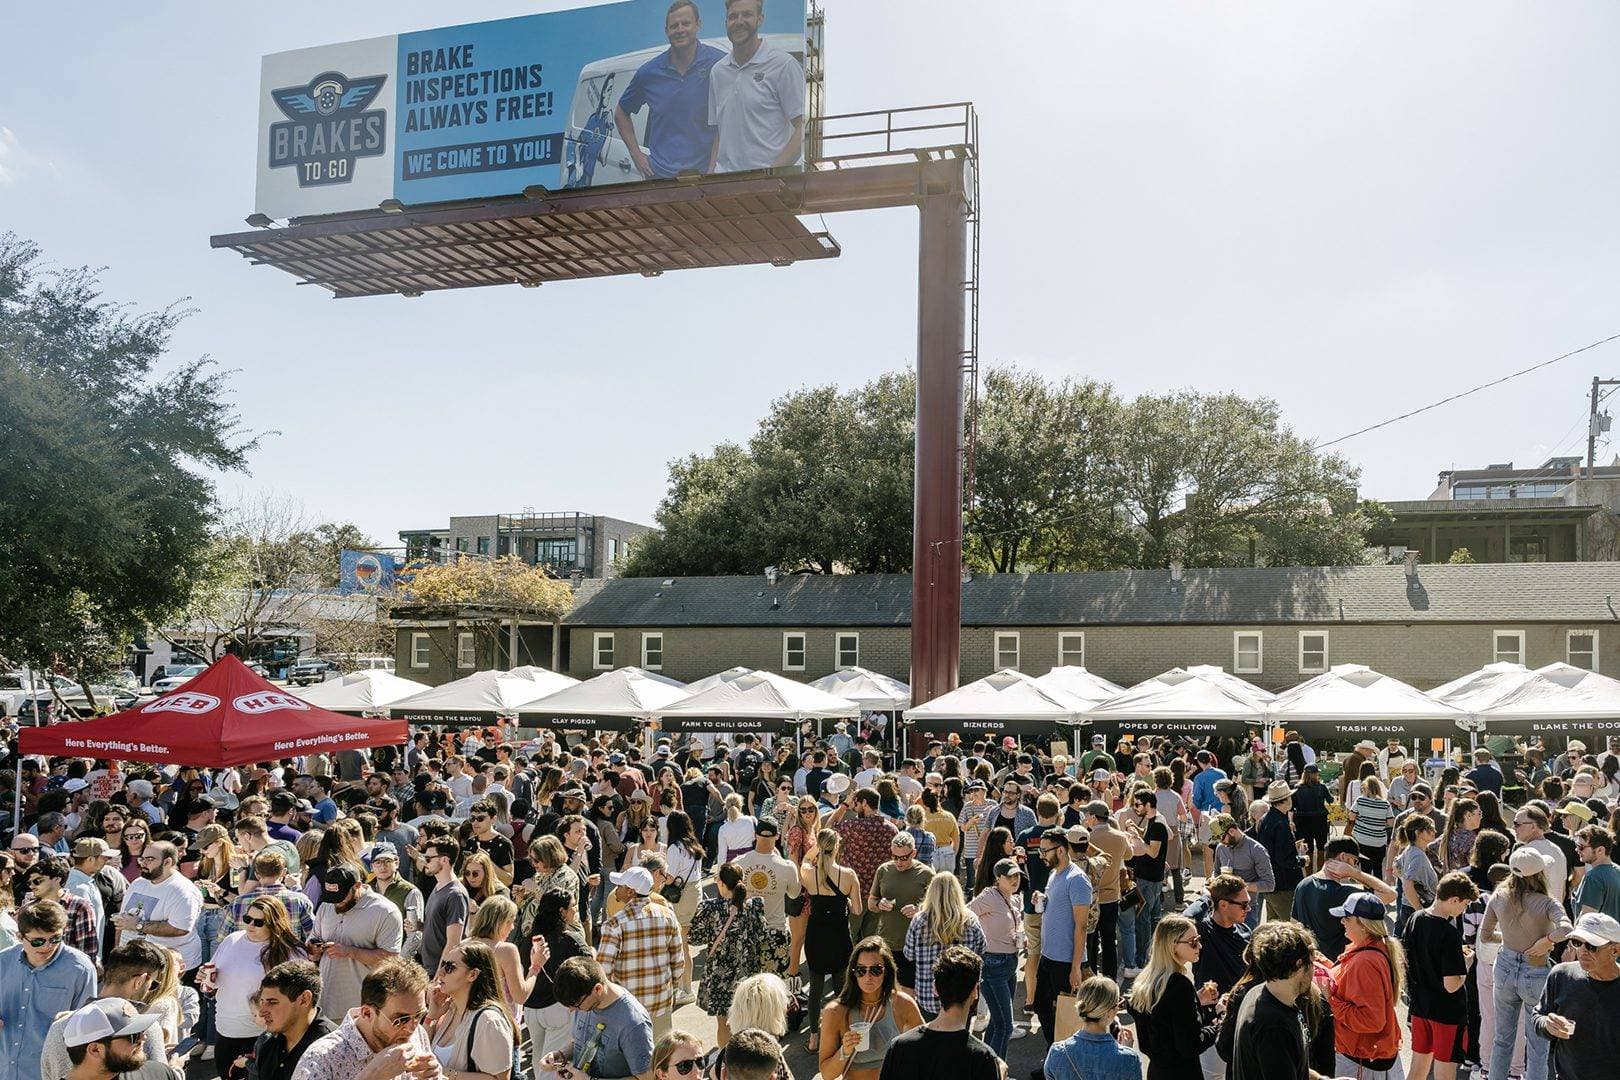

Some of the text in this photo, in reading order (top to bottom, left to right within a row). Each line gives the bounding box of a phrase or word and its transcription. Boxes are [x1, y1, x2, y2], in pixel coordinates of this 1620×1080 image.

[406, 44, 474, 76] BRAKE
[406, 63, 543, 104] INSPECTIONS
[405, 91, 553, 133] ALWAYS FREE!
[274, 116, 380, 160] BRAKES
[408, 139, 551, 174] WE COME TO YOU!
[962, 721, 1005, 729] BIZNERDS
[1118, 722, 1149, 730] POPES
[1166, 723, 1217, 731] CHILITOWN
[1532, 723, 1569, 731] BLAME
[65, 738, 170, 754] Here Everything's Better.
[274, 732, 370, 750] Here Everything's Better.
